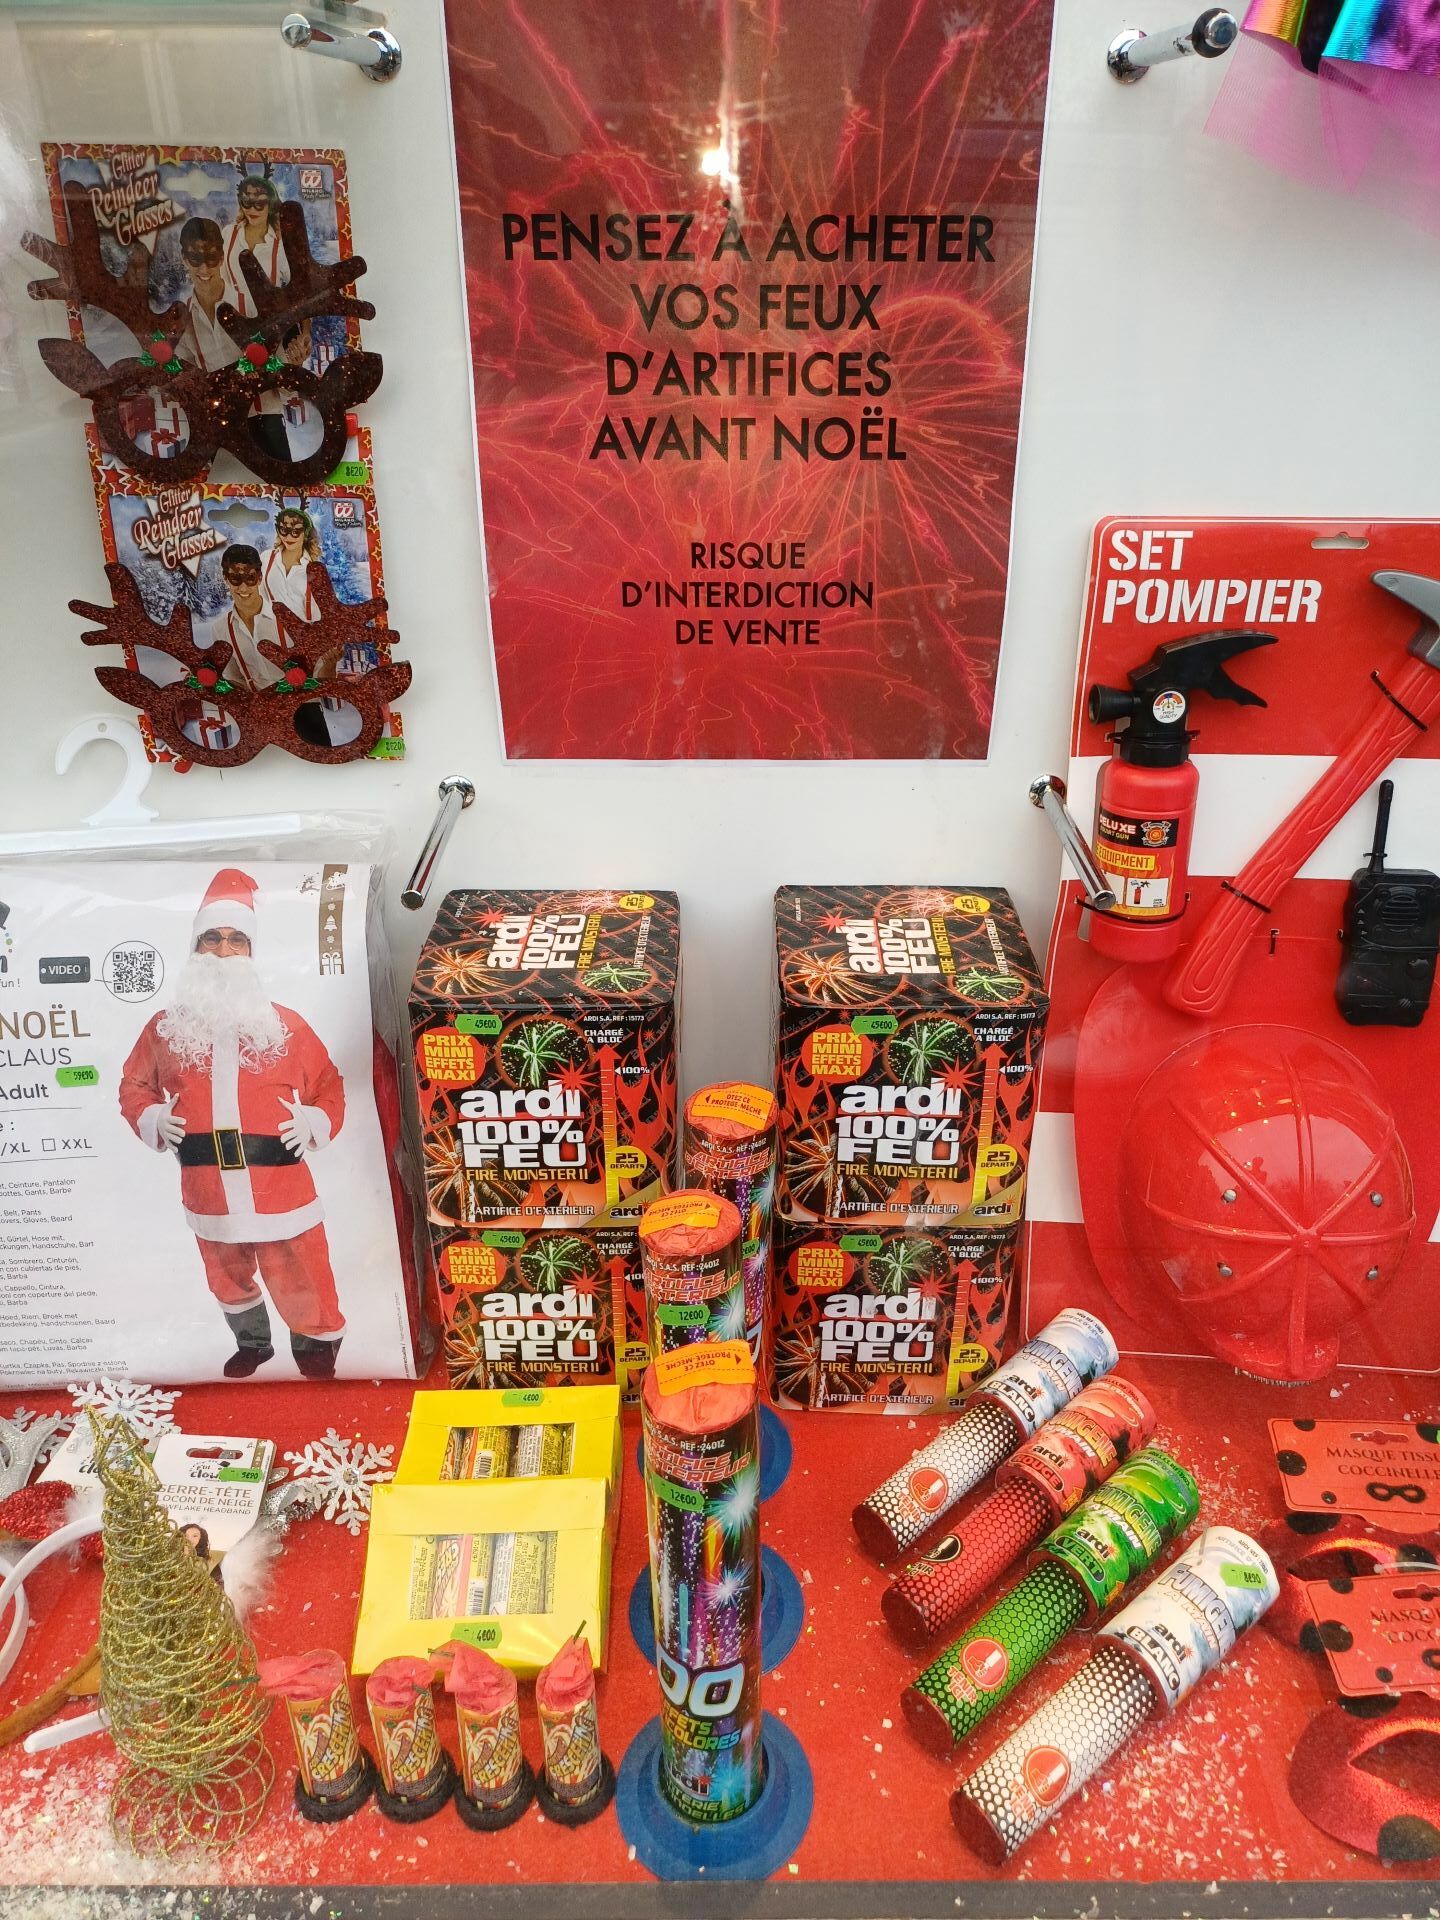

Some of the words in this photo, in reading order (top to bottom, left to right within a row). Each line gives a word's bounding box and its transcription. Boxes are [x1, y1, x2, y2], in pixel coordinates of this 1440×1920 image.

[503, 212, 696, 263] PENSEZ
[766, 212, 995, 263] ACHETER
[630, 283, 738, 332] VOS
[759, 284, 881, 331] FEUX
[589, 414, 756, 463] AVANT
[774, 405, 907, 462] NOËL
[159, 488, 192, 513] Glitter
[134, 505, 202, 552] Reindeer
[161, 528, 215, 568] Glasses
[1108, 530, 1194, 571] SET
[691, 542, 806, 569] RISQUE
[1102, 579, 1322, 623] POMPIER
[676, 620, 713, 645] DE
[723, 619, 820, 645] VENTE
[48, 965, 81, 975] VIDEO
[423, 1033, 473, 1046] PRIX
[812, 1032, 861, 1043] PRIX
[986, 1034, 1011, 1042] BLOC
[423, 1045, 474, 1058] MINI
[812, 1043, 863, 1054] MINI
[425, 1057, 475, 1070] EFFETS
[811, 1054, 862, 1065] EFFETS
[426, 1068, 476, 1081] MAXI
[811, 1065, 861, 1076] MAXI
[1006, 1065, 1033, 1073] 100%
[459, 1079, 583, 1119] ardi
[840, 1077, 962, 1116] ardi
[457, 1119, 584, 1144] 100%
[835, 1115, 960, 1141] 100%
[62, 1139, 93, 1150] XXL
[463, 1143, 588, 1168] FEU
[615, 1152, 639, 1163] 25
[837, 1138, 960, 1165] FEU
[986, 1150, 1011, 1161] 25
[466, 1169, 499, 1180] FIRE
[503, 1169, 576, 1181] MONSTER
[837, 1164, 870, 1176] FIRE
[873, 1165, 946, 1178] MONSTER
[474, 1206, 522, 1216] ARTIFICE
[839, 1202, 887, 1214] ARTIFICE
[973, 1203, 1012, 1216] ardi
[448, 1246, 494, 1256] PRIX
[798, 1248, 843, 1258] PRIX
[959, 1251, 982, 1259] BLOC
[449, 1255, 495, 1265] MINI
[798, 1258, 844, 1268] MINI
[450, 1265, 496, 1275] EFFETS
[797, 1267, 843, 1277] EFFETS
[451, 1275, 497, 1285] MAXI
[797, 1277, 843, 1287] MAXI
[977, 1276, 1003, 1284] 100%
[482, 1285, 594, 1318] ardi
[823, 1288, 937, 1321] ardi
[479, 1319, 595, 1341] 100%
[819, 1320, 935, 1343] 100%
[484, 1339, 598, 1361] FEU
[624, 1347, 646, 1357] 25
[820, 1341, 935, 1362] FEU
[959, 1349, 981, 1358] 25
[487, 1362, 516, 1372] FIRE
[521, 1362, 589, 1373] MONSTER
[695, 1359, 716, 1368] OTEZ
[820, 1362, 850, 1373] FIRE
[854, 1363, 923, 1374] MONSTER
[1008, 1374, 1039, 1401] ardi
[989, 1382, 1034, 1421] BLANC
[1033, 1445, 1066, 1468] ardi
[1326, 1447, 1397, 1462] MASQUE
[1013, 1455, 1061, 1490] ROUGE
[200, 1496, 215, 1505] DE
[217, 1498, 255, 1508] NEIGE
[1077, 1529, 1111, 1559] ardi
[1061, 1538, 1102, 1575] VERT
[1154, 1623, 1186, 1661] ardi
[1131, 1629, 1179, 1690] BLANC
